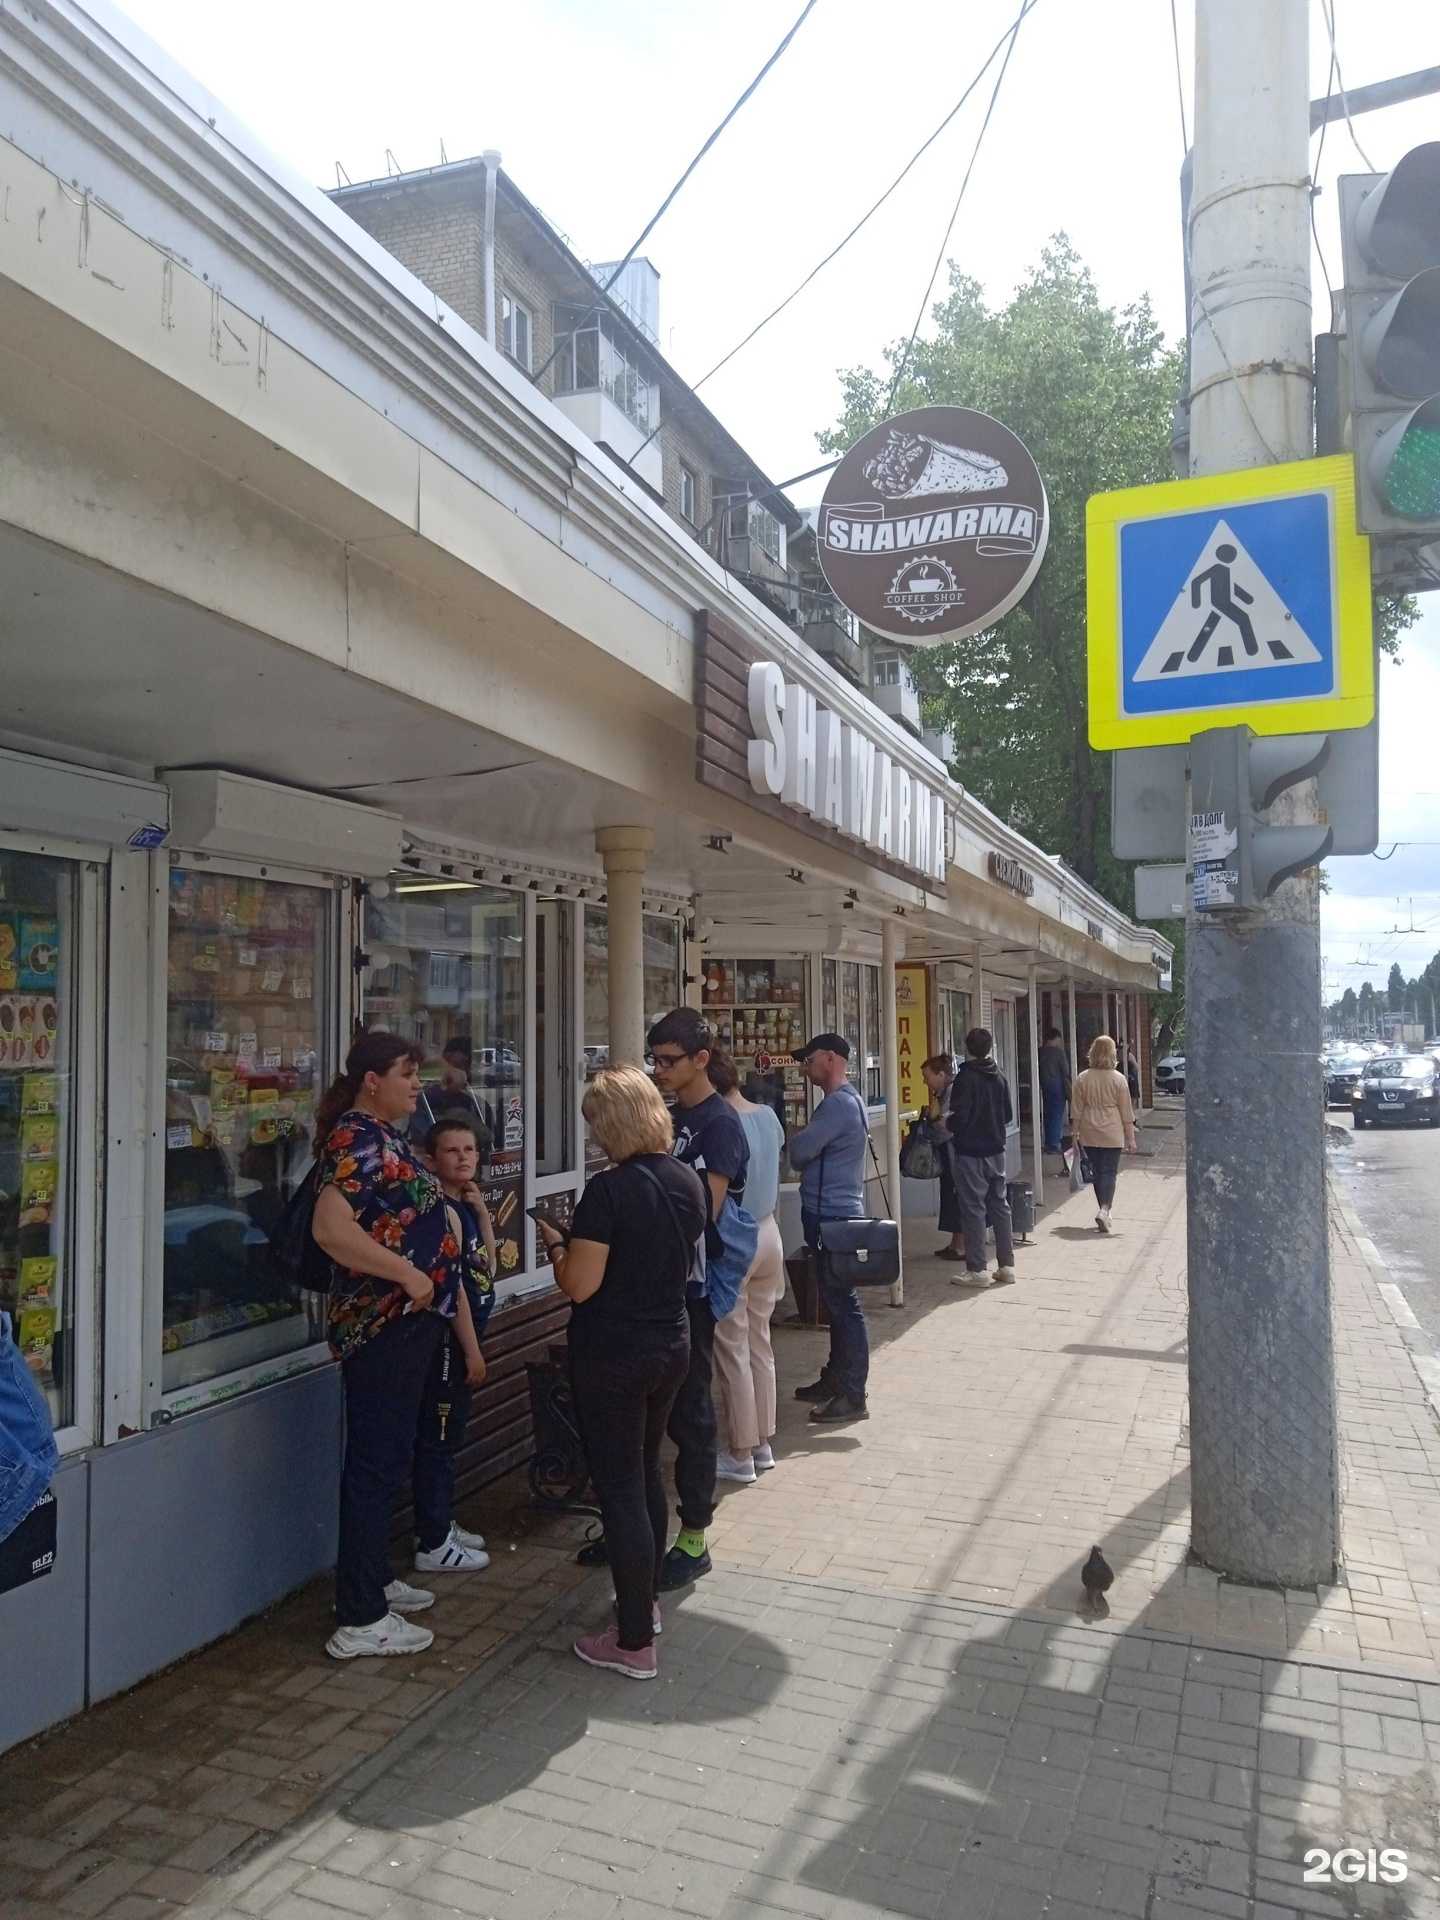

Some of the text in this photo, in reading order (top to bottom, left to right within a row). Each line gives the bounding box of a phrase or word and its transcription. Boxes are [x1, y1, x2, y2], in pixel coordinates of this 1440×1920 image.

[828, 506, 1034, 552] SHAWARMA
[886, 592, 963, 605] COFFEE SHOP
[747, 661, 946, 883] SHAWARMA
[32, 1551, 53, 1570] TELE2
